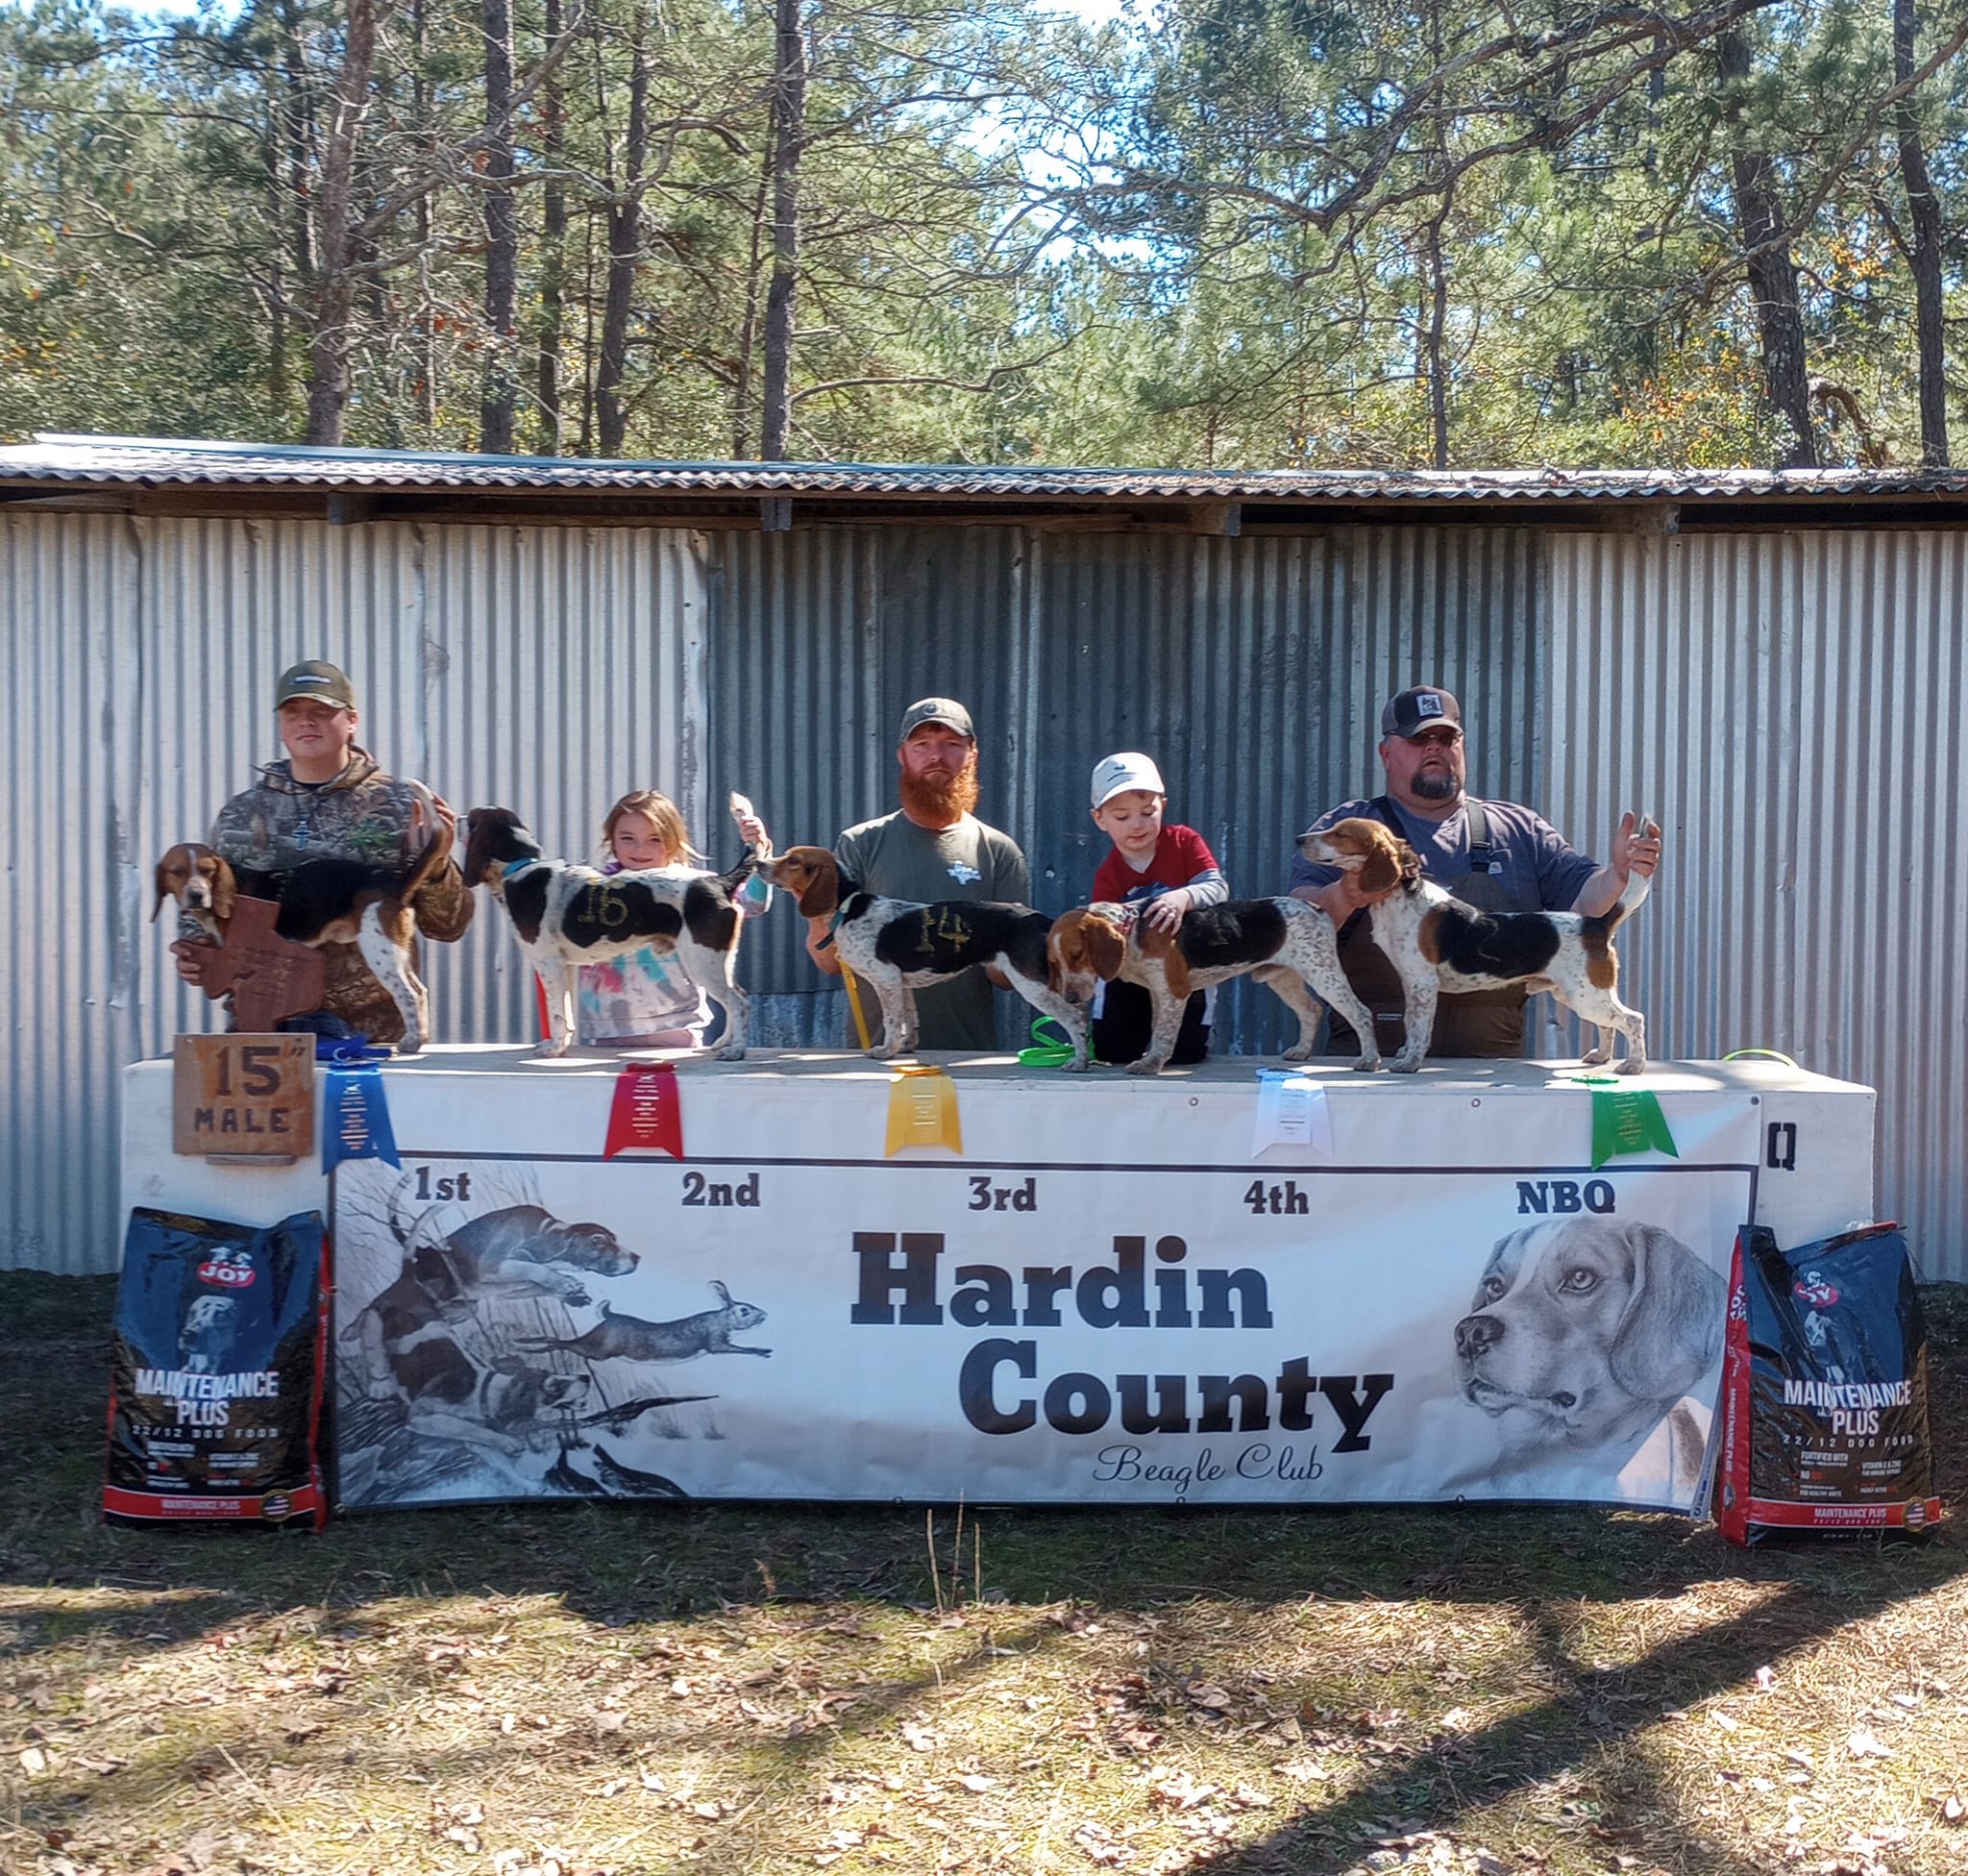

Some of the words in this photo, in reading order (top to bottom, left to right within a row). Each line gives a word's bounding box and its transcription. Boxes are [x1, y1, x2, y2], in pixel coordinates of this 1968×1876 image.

[917, 906, 972, 953] 14
[194, 1107, 291, 1133] MALE
[1767, 1122, 1797, 1172] Q
[415, 1166, 472, 1201] 1st
[681, 1172, 761, 1207] 2nd
[968, 1176, 1038, 1212] 3rd
[1242, 1180, 1310, 1215] 4th
[1515, 1180, 1616, 1214] NBQ
[199, 1265, 254, 1282] JOY
[849, 1231, 1274, 1329] Hardin
[135, 1369, 280, 1399] MAINTENANCE
[958, 1337, 1395, 1453] County
[1784, 1379, 1912, 1409] MAINTENANCE
[177, 1399, 231, 1426] PLUS
[1833, 1410, 1880, 1436] PLUS
[1783, 1434, 1837, 1447] 22/12
[1847, 1439, 1876, 1448] DOG
[1092, 1444, 1227, 1493] Beagle
[1235, 1443, 1324, 1481] Club
[1813, 1507, 1867, 1518] MAINTENANCE
[1868, 1508, 1887, 1518] PLUS
